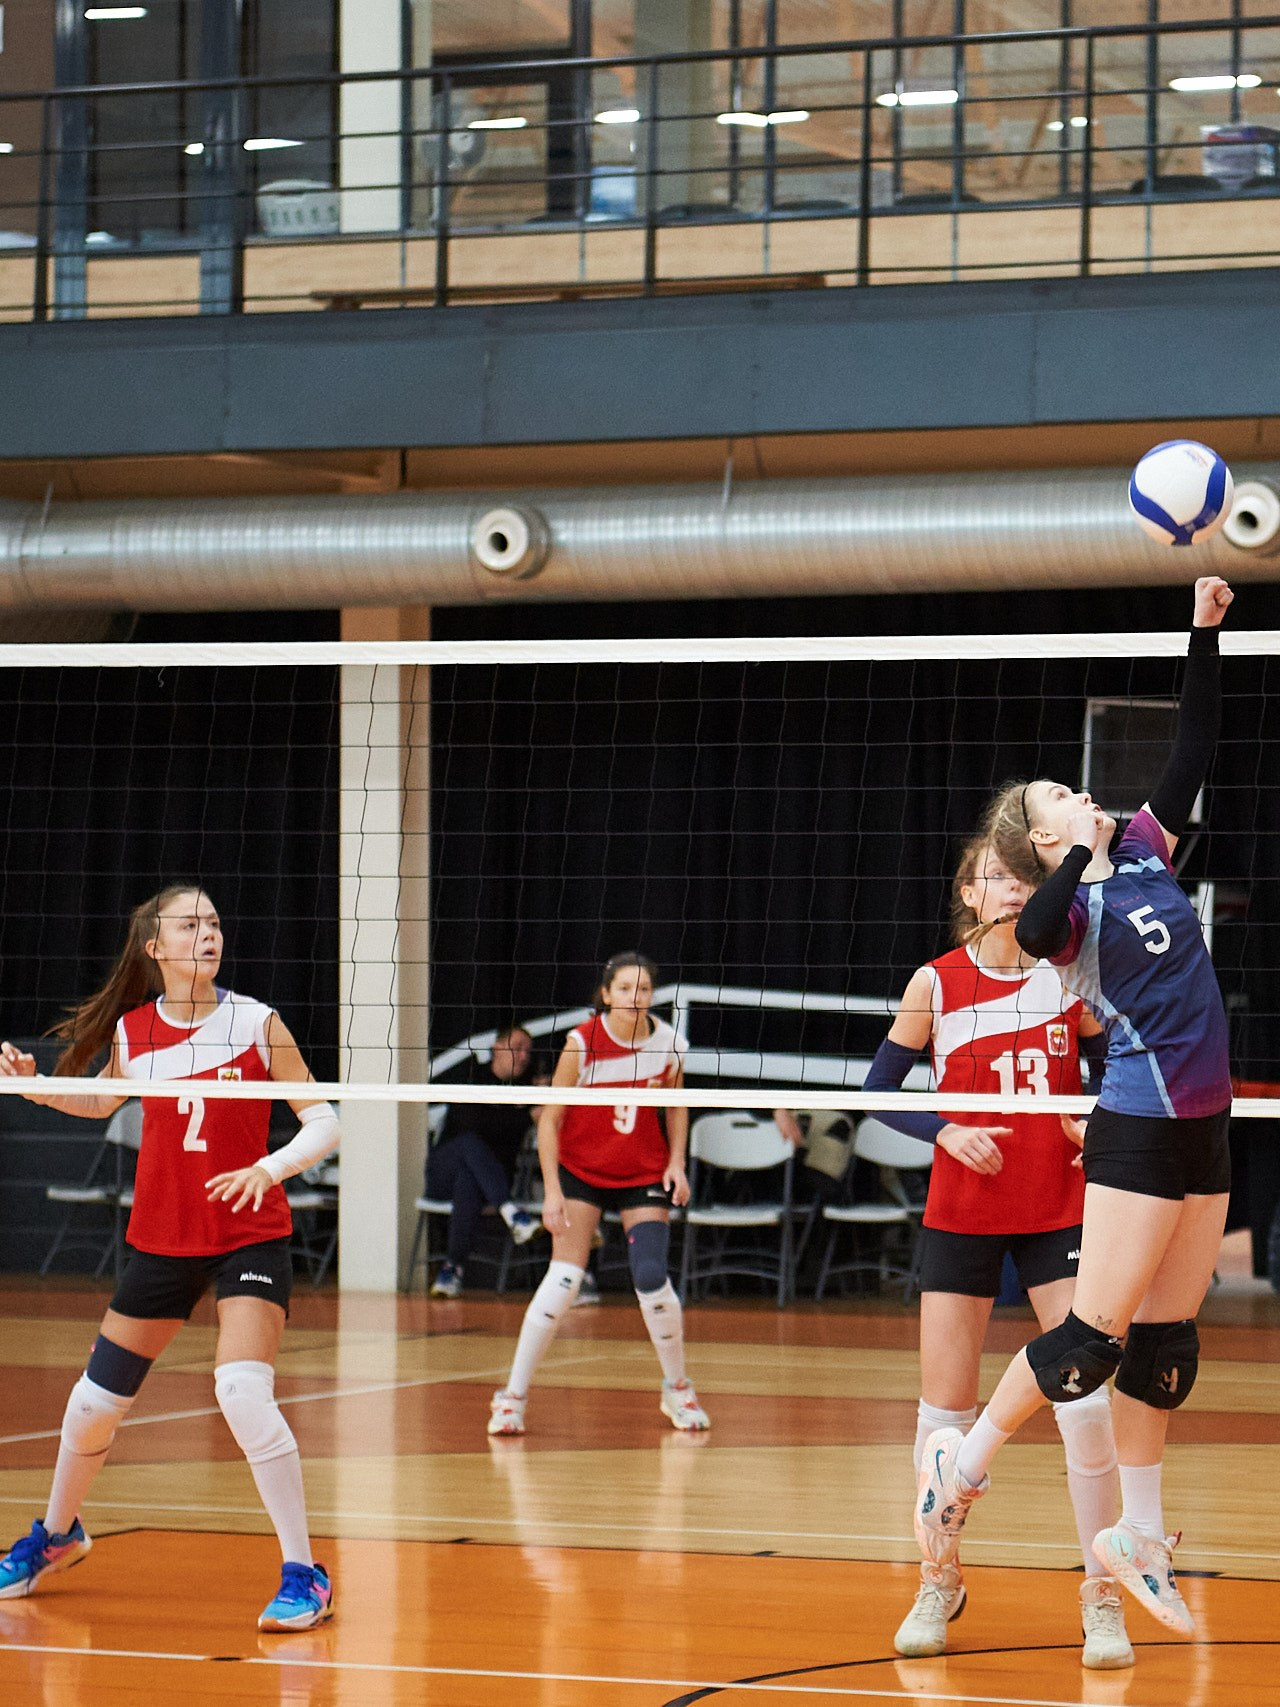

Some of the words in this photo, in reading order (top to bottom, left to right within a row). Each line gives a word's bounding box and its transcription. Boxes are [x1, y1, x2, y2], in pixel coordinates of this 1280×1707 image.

[1126, 904, 1171, 955] 5
[990, 1047, 1049, 1114] 13
[177, 1096, 207, 1152] 2
[613, 1104, 638, 1135] 9
